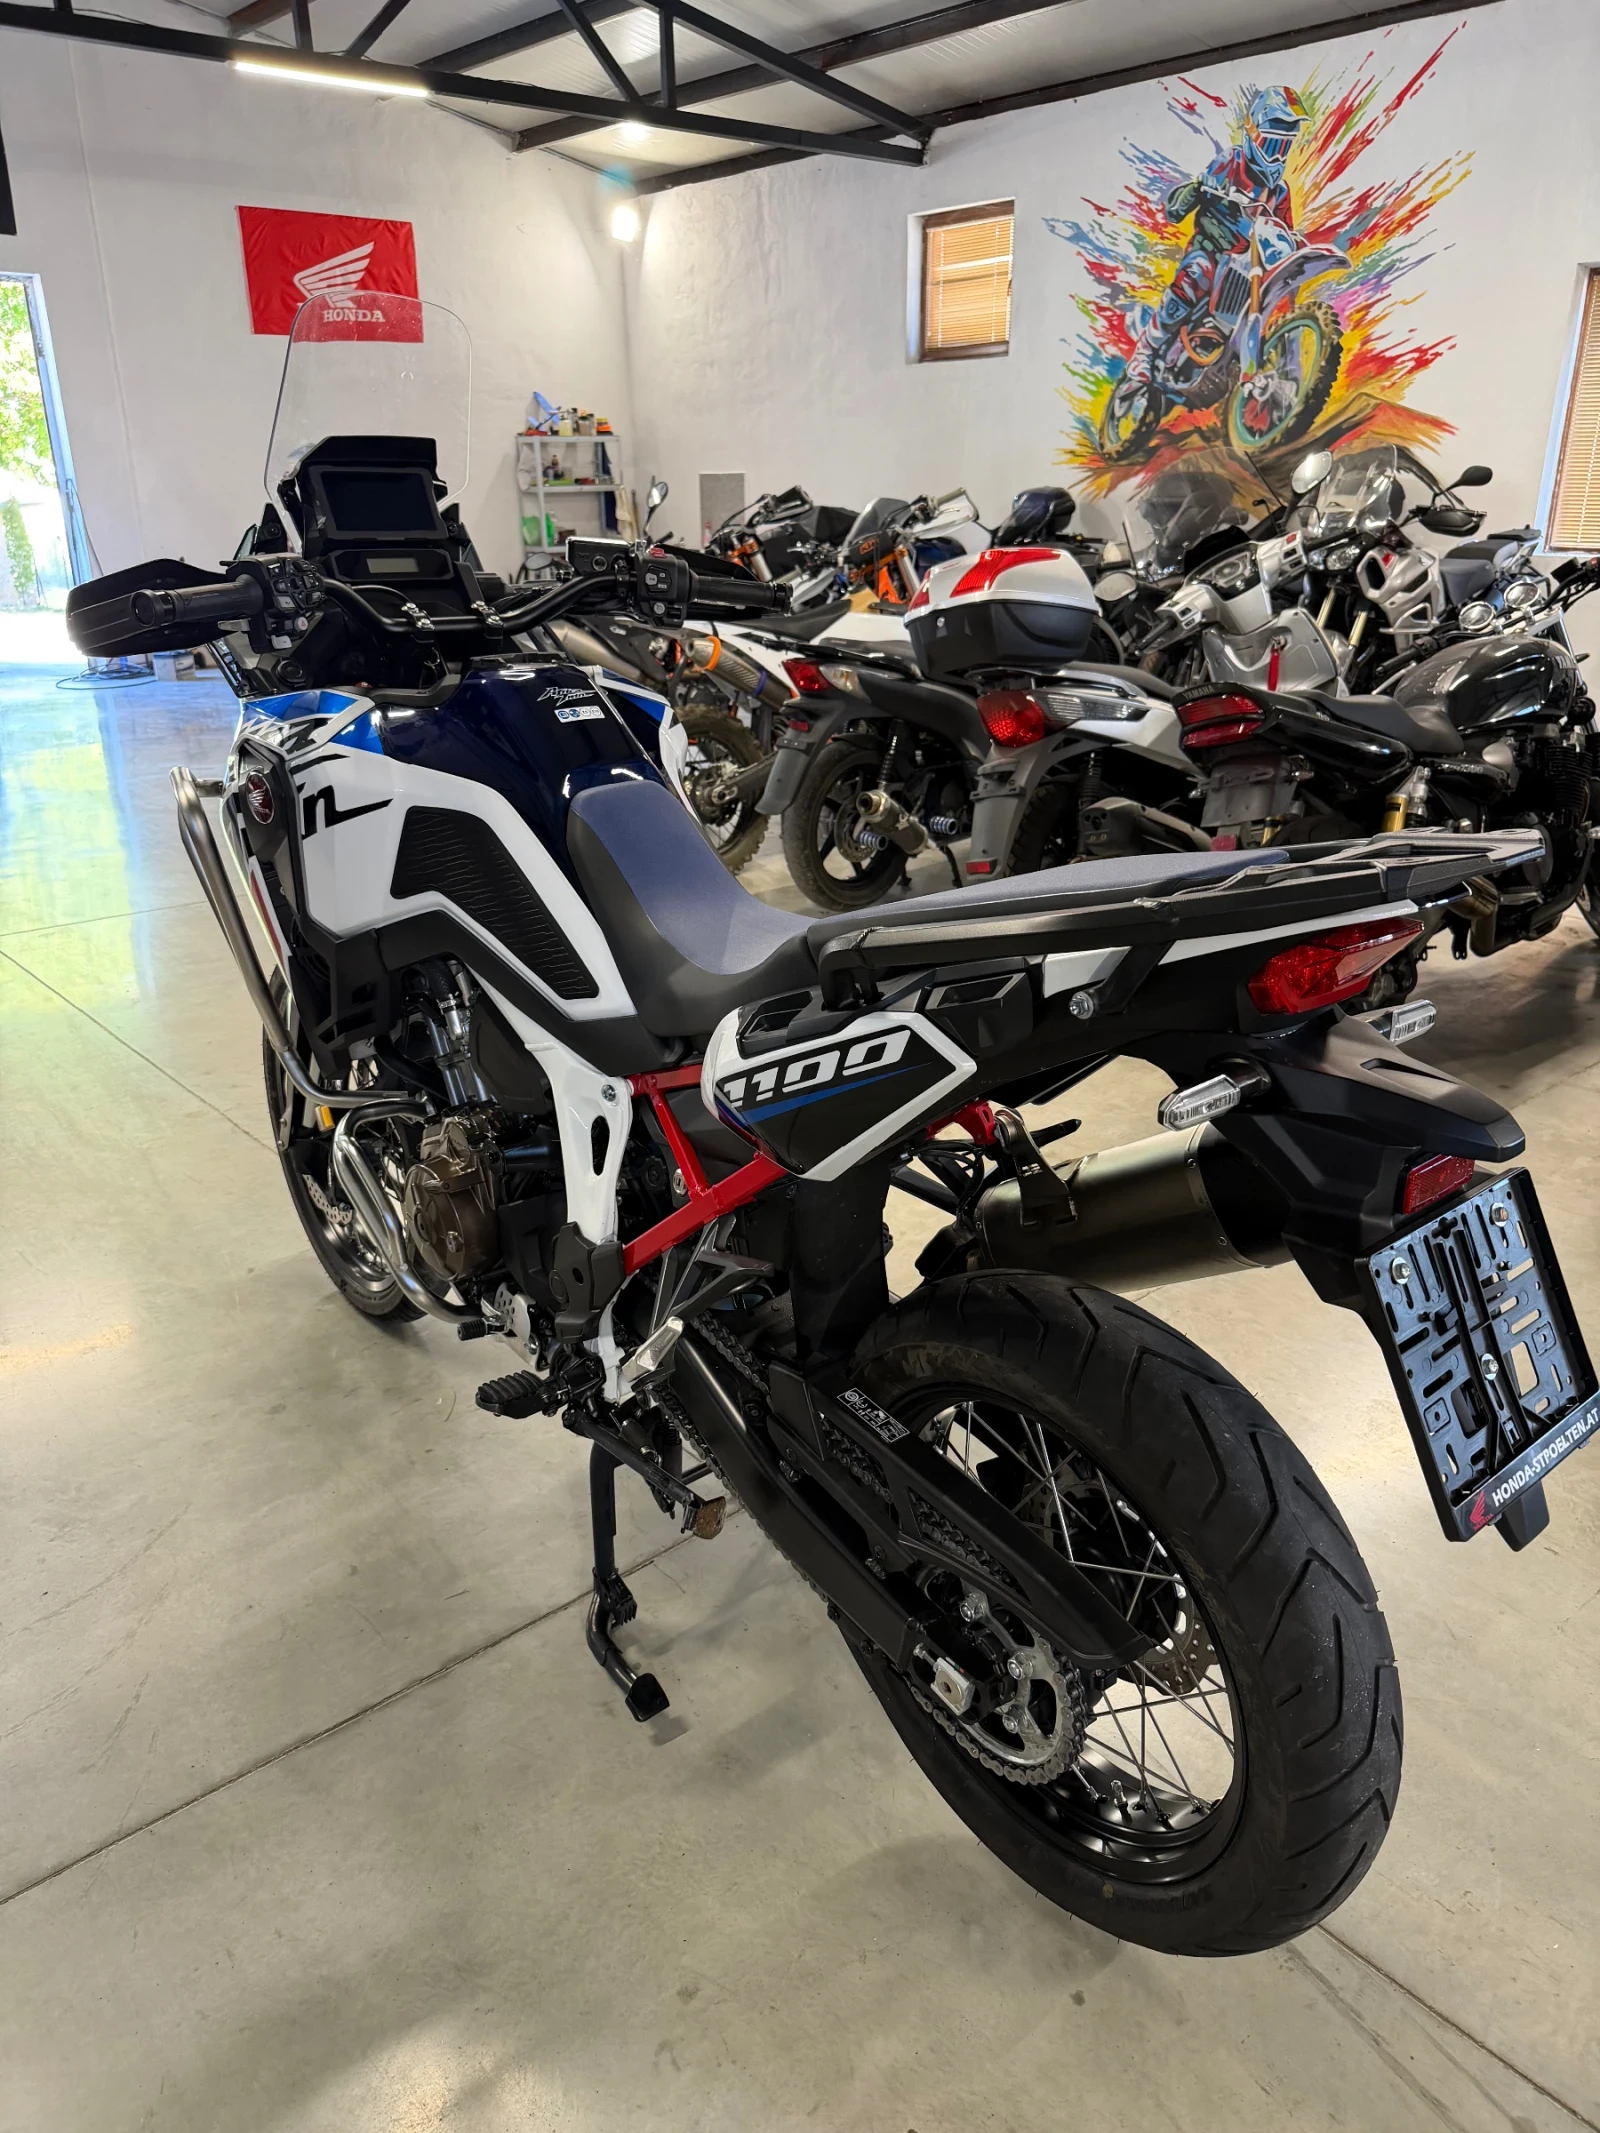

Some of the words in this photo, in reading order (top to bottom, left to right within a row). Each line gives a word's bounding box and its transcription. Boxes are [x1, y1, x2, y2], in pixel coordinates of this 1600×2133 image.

[323, 308, 386, 322] HONDA
[1182, 686, 1215, 700] YAMAHA
[723, 1029, 911, 1108] 1100
[1491, 1407, 1600, 1507] HONDA-STPOELTEN.AT
